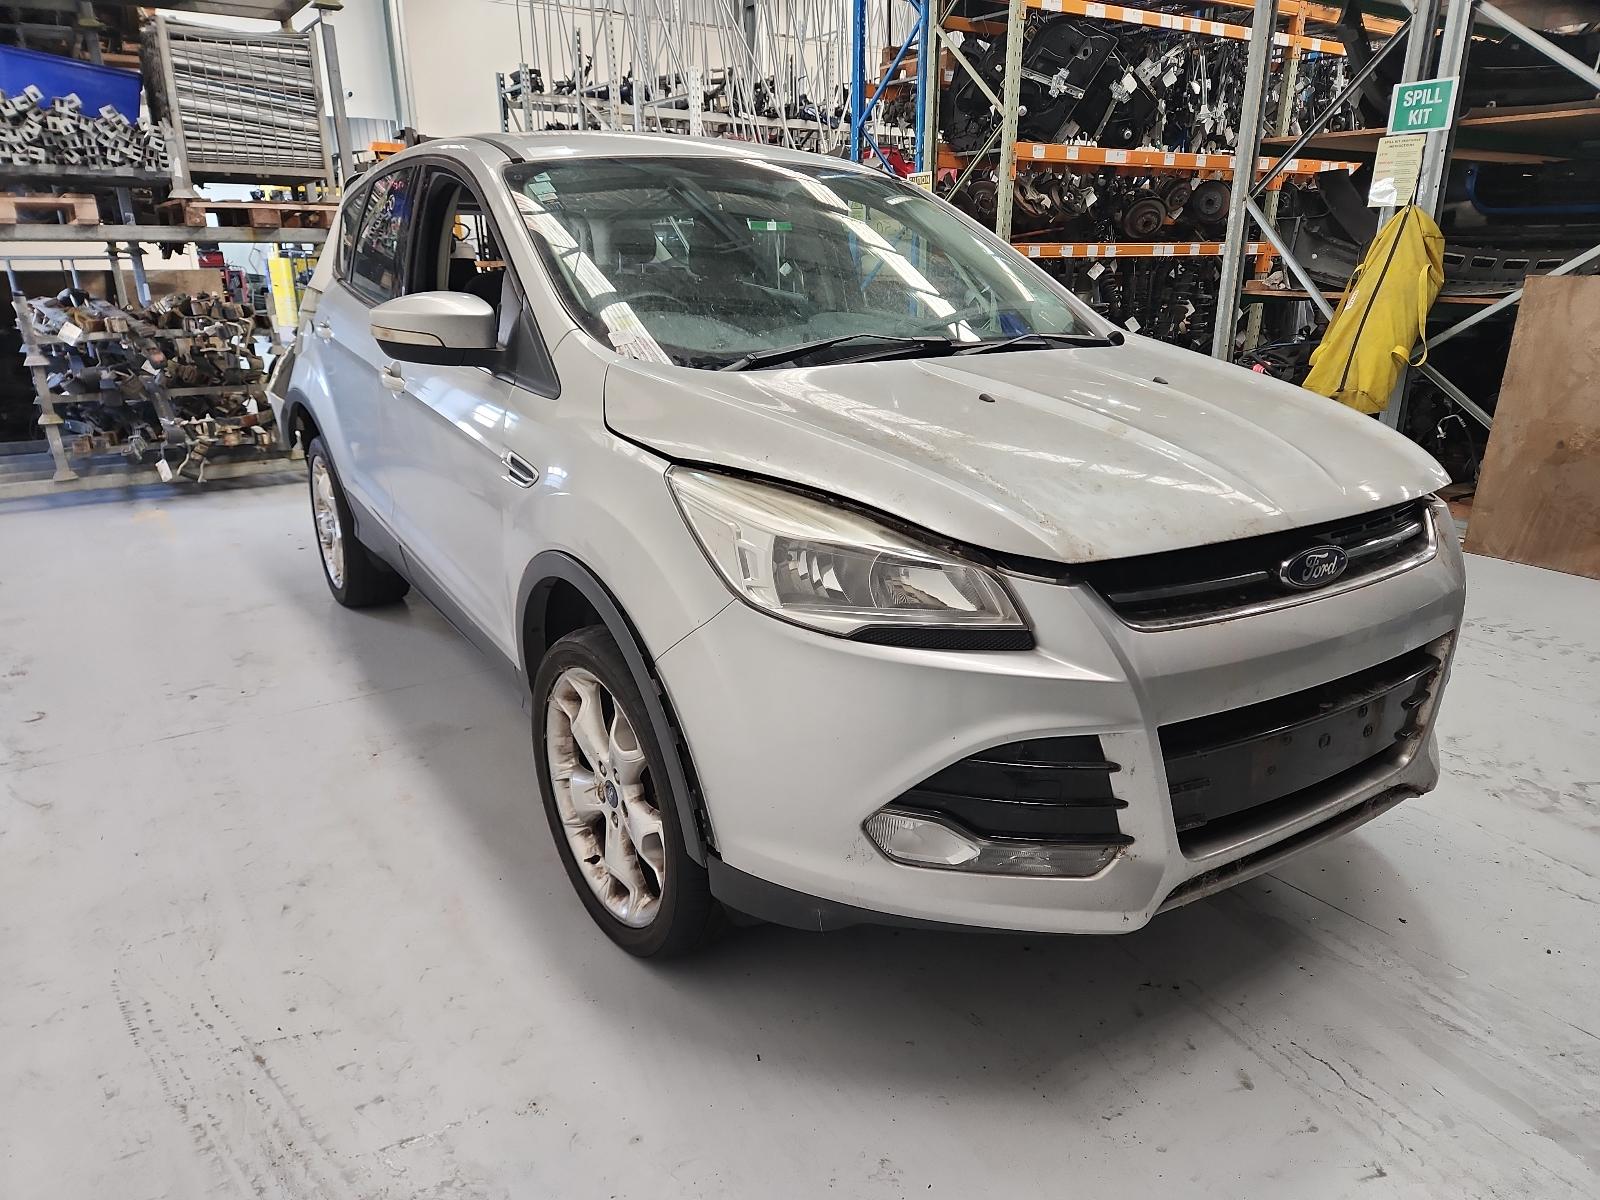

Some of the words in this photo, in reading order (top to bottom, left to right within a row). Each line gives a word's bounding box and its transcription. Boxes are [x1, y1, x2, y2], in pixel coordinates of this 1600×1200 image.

[1403, 87, 1442, 107] SPILL
[1408, 108, 1432, 126] KIT
[1302, 552, 1338, 581] Ford
